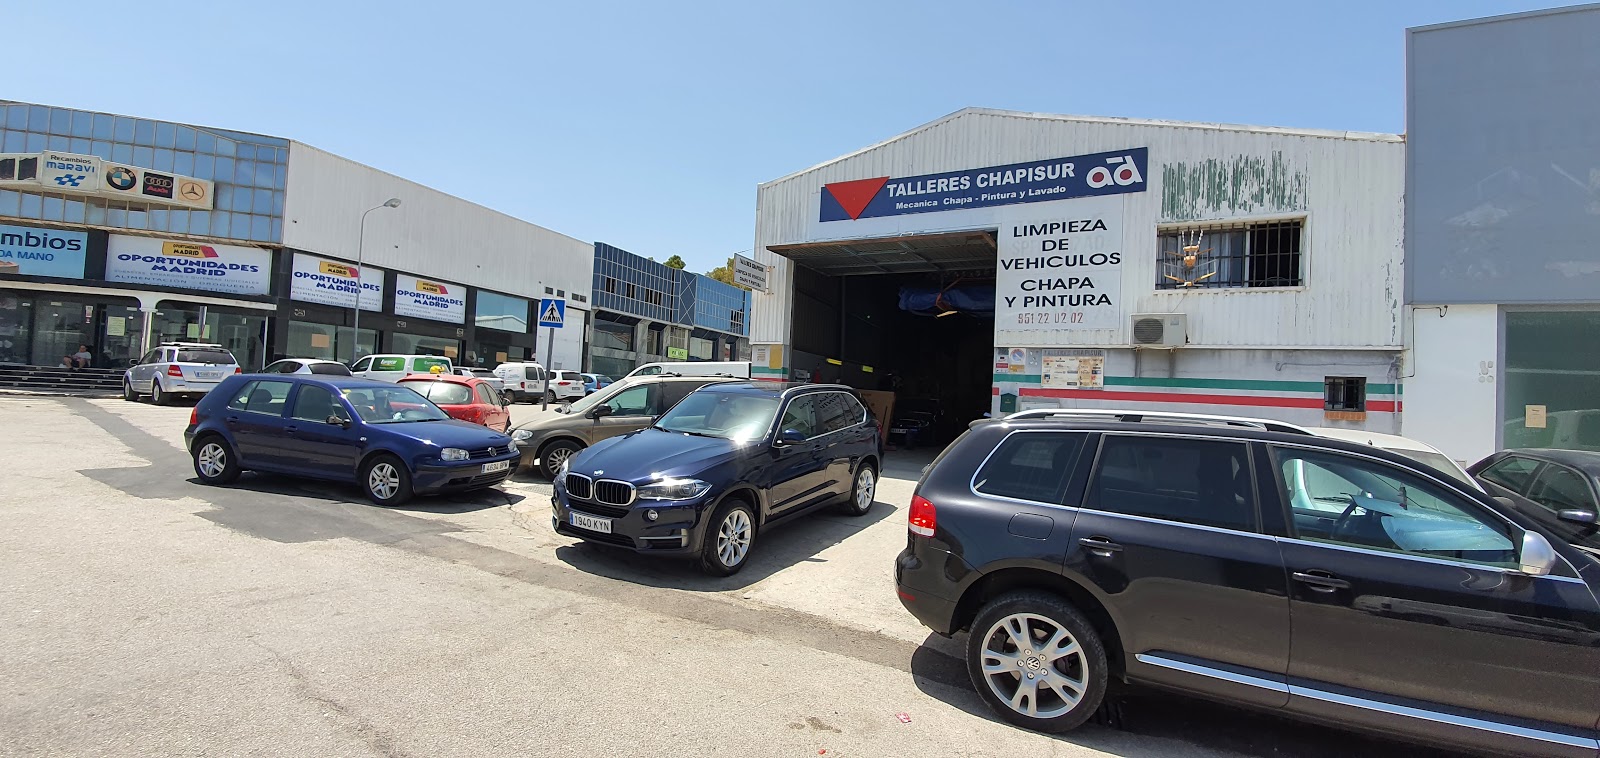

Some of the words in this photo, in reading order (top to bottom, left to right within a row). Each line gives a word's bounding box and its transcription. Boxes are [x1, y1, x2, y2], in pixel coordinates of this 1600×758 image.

[50, 154, 92, 164] Recambios
[887, 172, 971, 198] TALLERES
[976, 162, 1076, 188] CHAPISUR
[146, 186, 168, 194] Audi
[896, 198, 938, 210] Mecanica
[943, 196, 973, 207] Chapa
[981, 192, 1016, 202] Pintura
[1019, 190, 1026, 198] y
[1028, 186, 1067, 196] Lavado
[1013, 218, 1108, 238] LIMPIEZA
[1042, 238, 1070, 252] DE
[17, 251, 54, 262] MANO
[118, 254, 259, 272] OPORTUNIDADES
[1000, 252, 1121, 270] VEHICULOS
[151, 264, 226, 276] MADRID
[316, 282, 362, 294] MADRID
[1020, 276, 1095, 292] CHAPA
[397, 290, 464, 306] OPORTUNIDADES
[414, 299, 449, 309] MADRID
[1004, 296, 1017, 308] Y
[1024, 294, 1112, 308] PINTURA
[1018, 312, 1034, 324] 951
[1038, 312, 1050, 324] 22
[1070, 312, 1084, 324] 02
[574, 516, 592, 528] 1940
[594, 520, 609, 531] KYN
